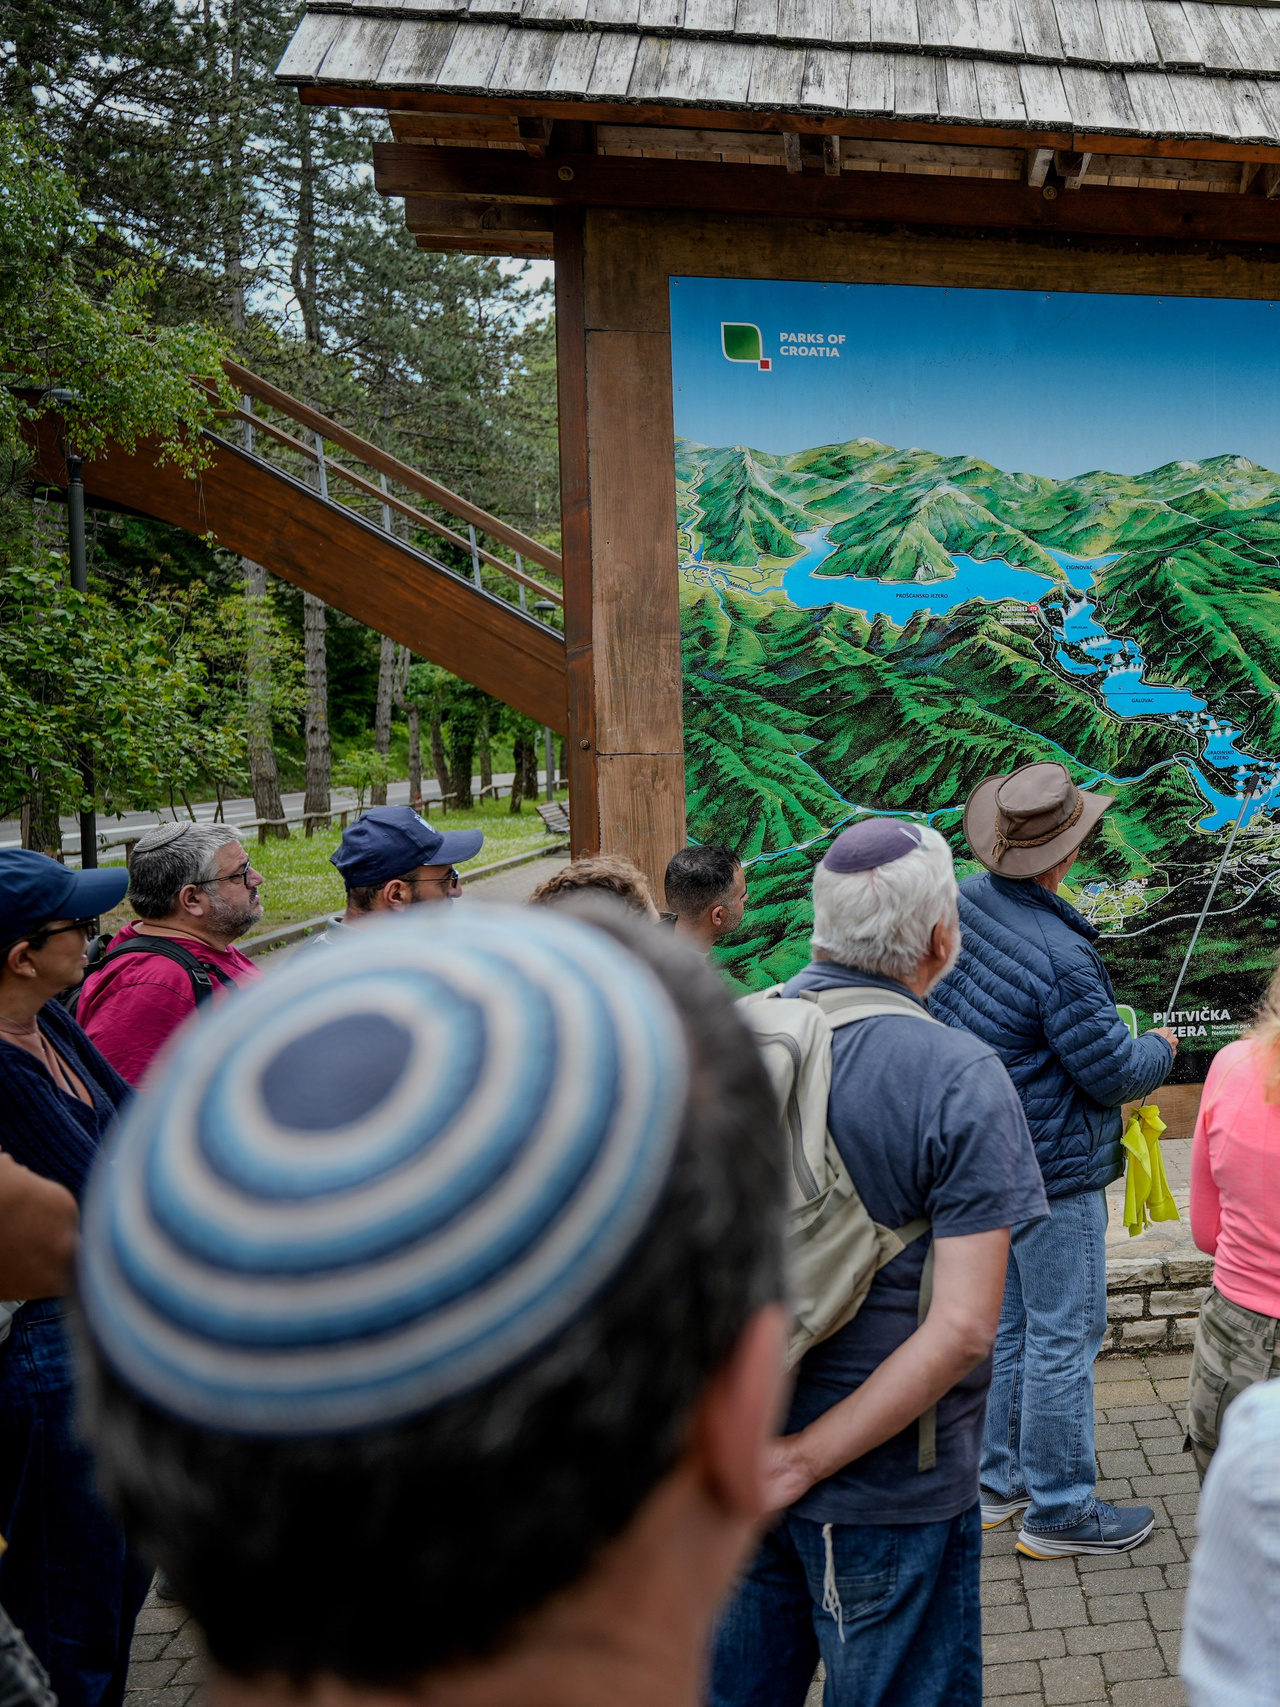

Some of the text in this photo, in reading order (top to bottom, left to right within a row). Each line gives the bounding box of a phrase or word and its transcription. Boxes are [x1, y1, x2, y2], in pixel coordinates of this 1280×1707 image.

[779, 332, 847, 345] PARKS OF
[779, 346, 840, 358] CROATIA
[1153, 1006, 1231, 1024] PLITVIČKA
[1170, 1025, 1208, 1038] ZERA
